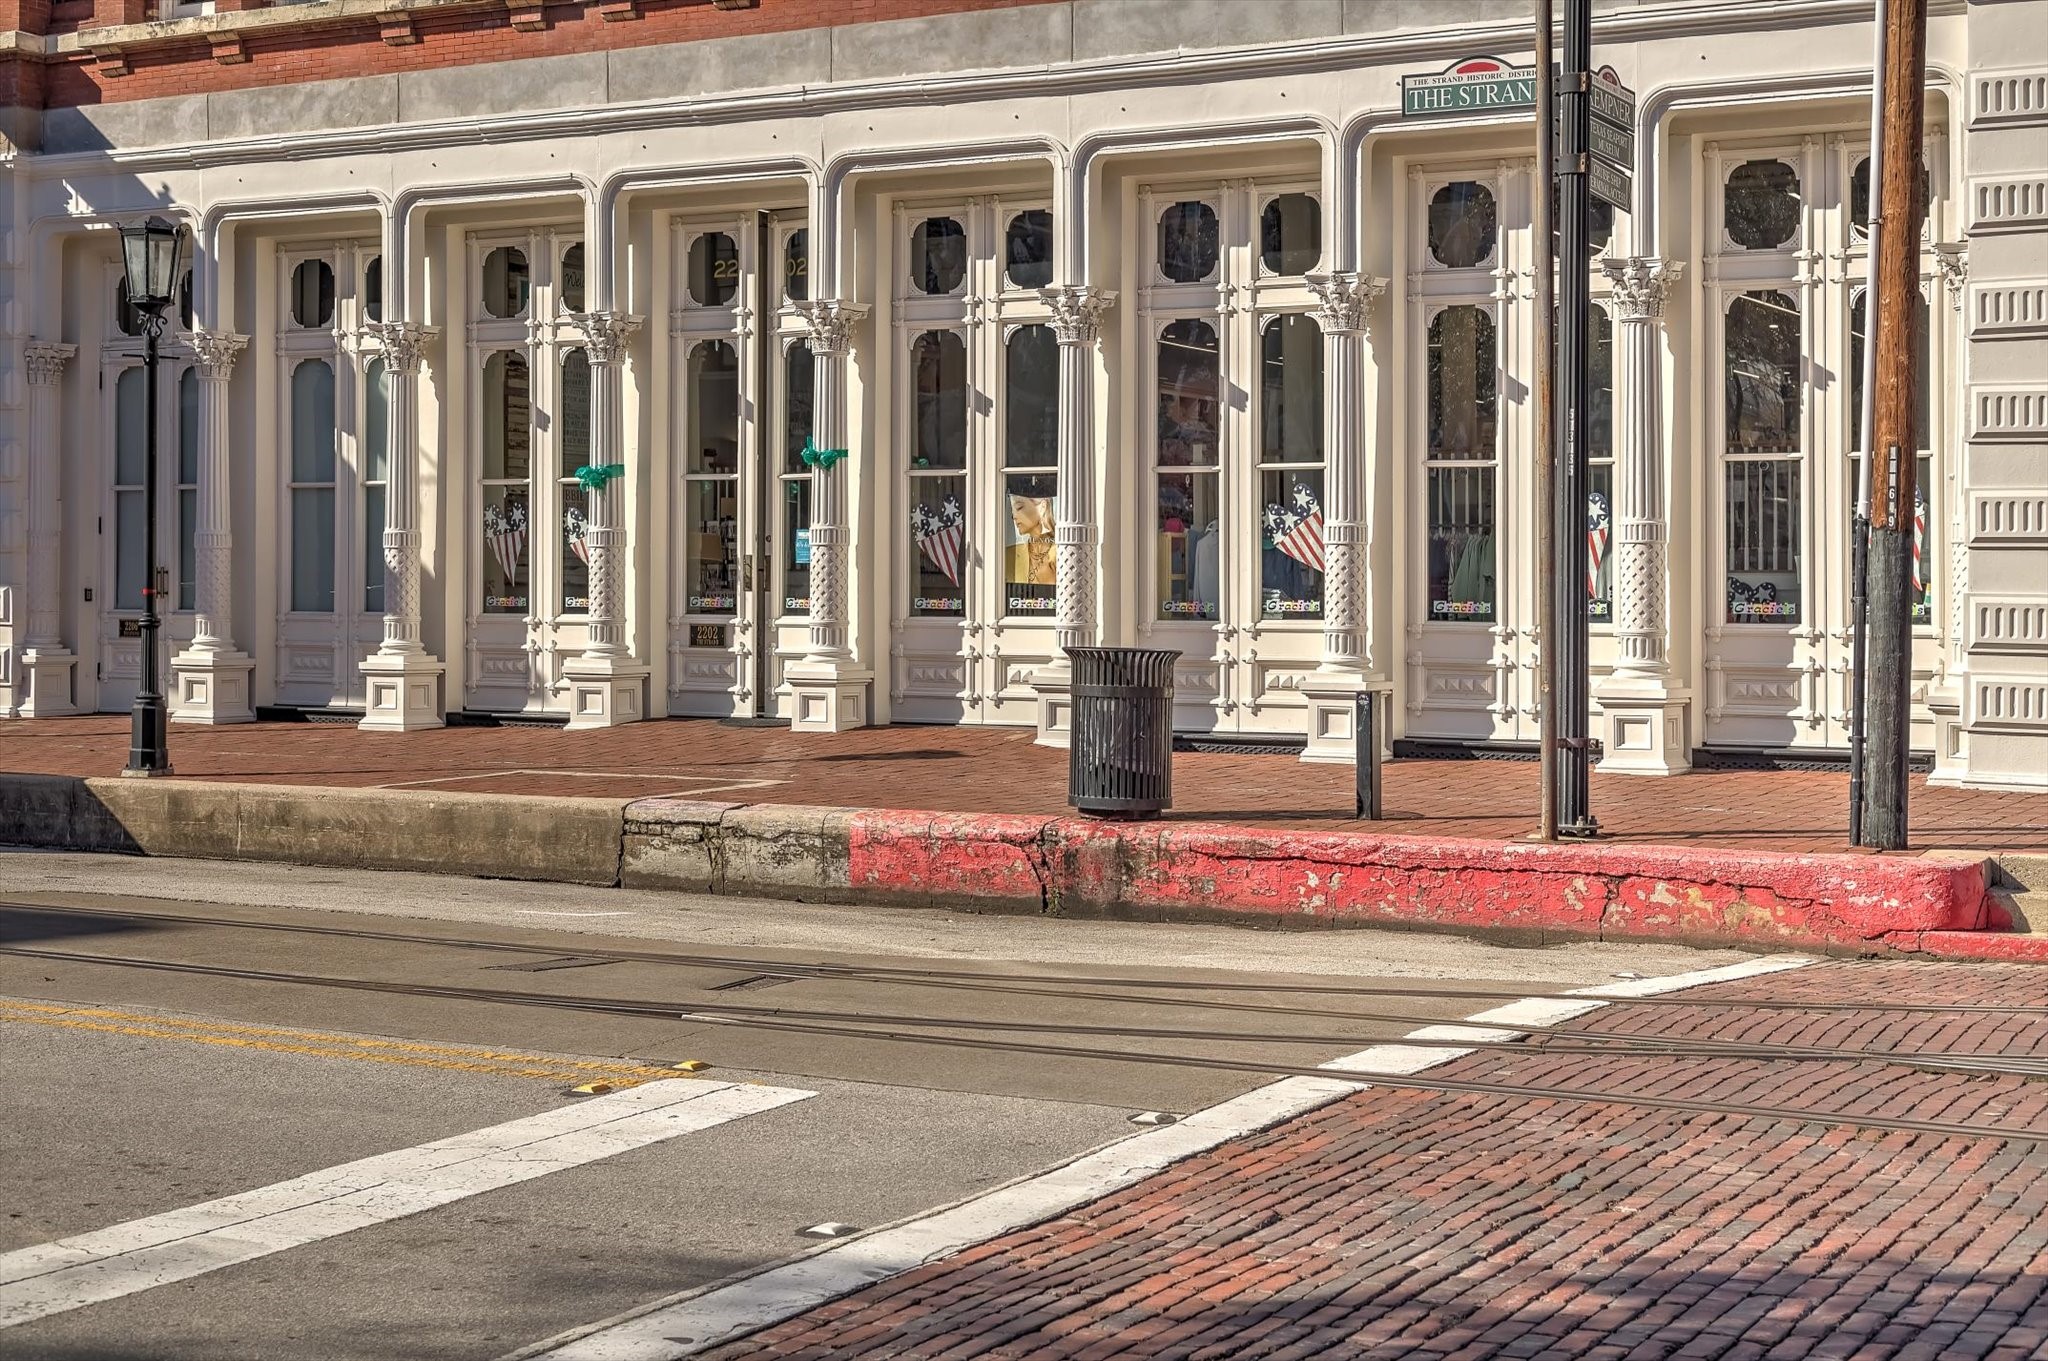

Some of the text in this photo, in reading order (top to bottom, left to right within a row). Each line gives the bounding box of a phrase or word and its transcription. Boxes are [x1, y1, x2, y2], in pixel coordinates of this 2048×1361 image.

[1413, 78, 1431, 86] THE
[1432, 75, 1464, 85] STRAND
[1467, 72, 1505, 82] HISTORIC
[1409, 80, 1536, 110] THE STRAN
[1590, 175, 1610, 197] ERMINAL
[713, 257, 808, 279] 22 02
[914, 597, 962, 609] Gracie's
[1163, 600, 1214, 612] Gracie's
[1266, 599, 1320, 612] Gracie's
[1434, 600, 1491, 613] Gracie's
[1733, 601, 1795, 615] Gracie's
[697, 625, 718, 639] 2202
